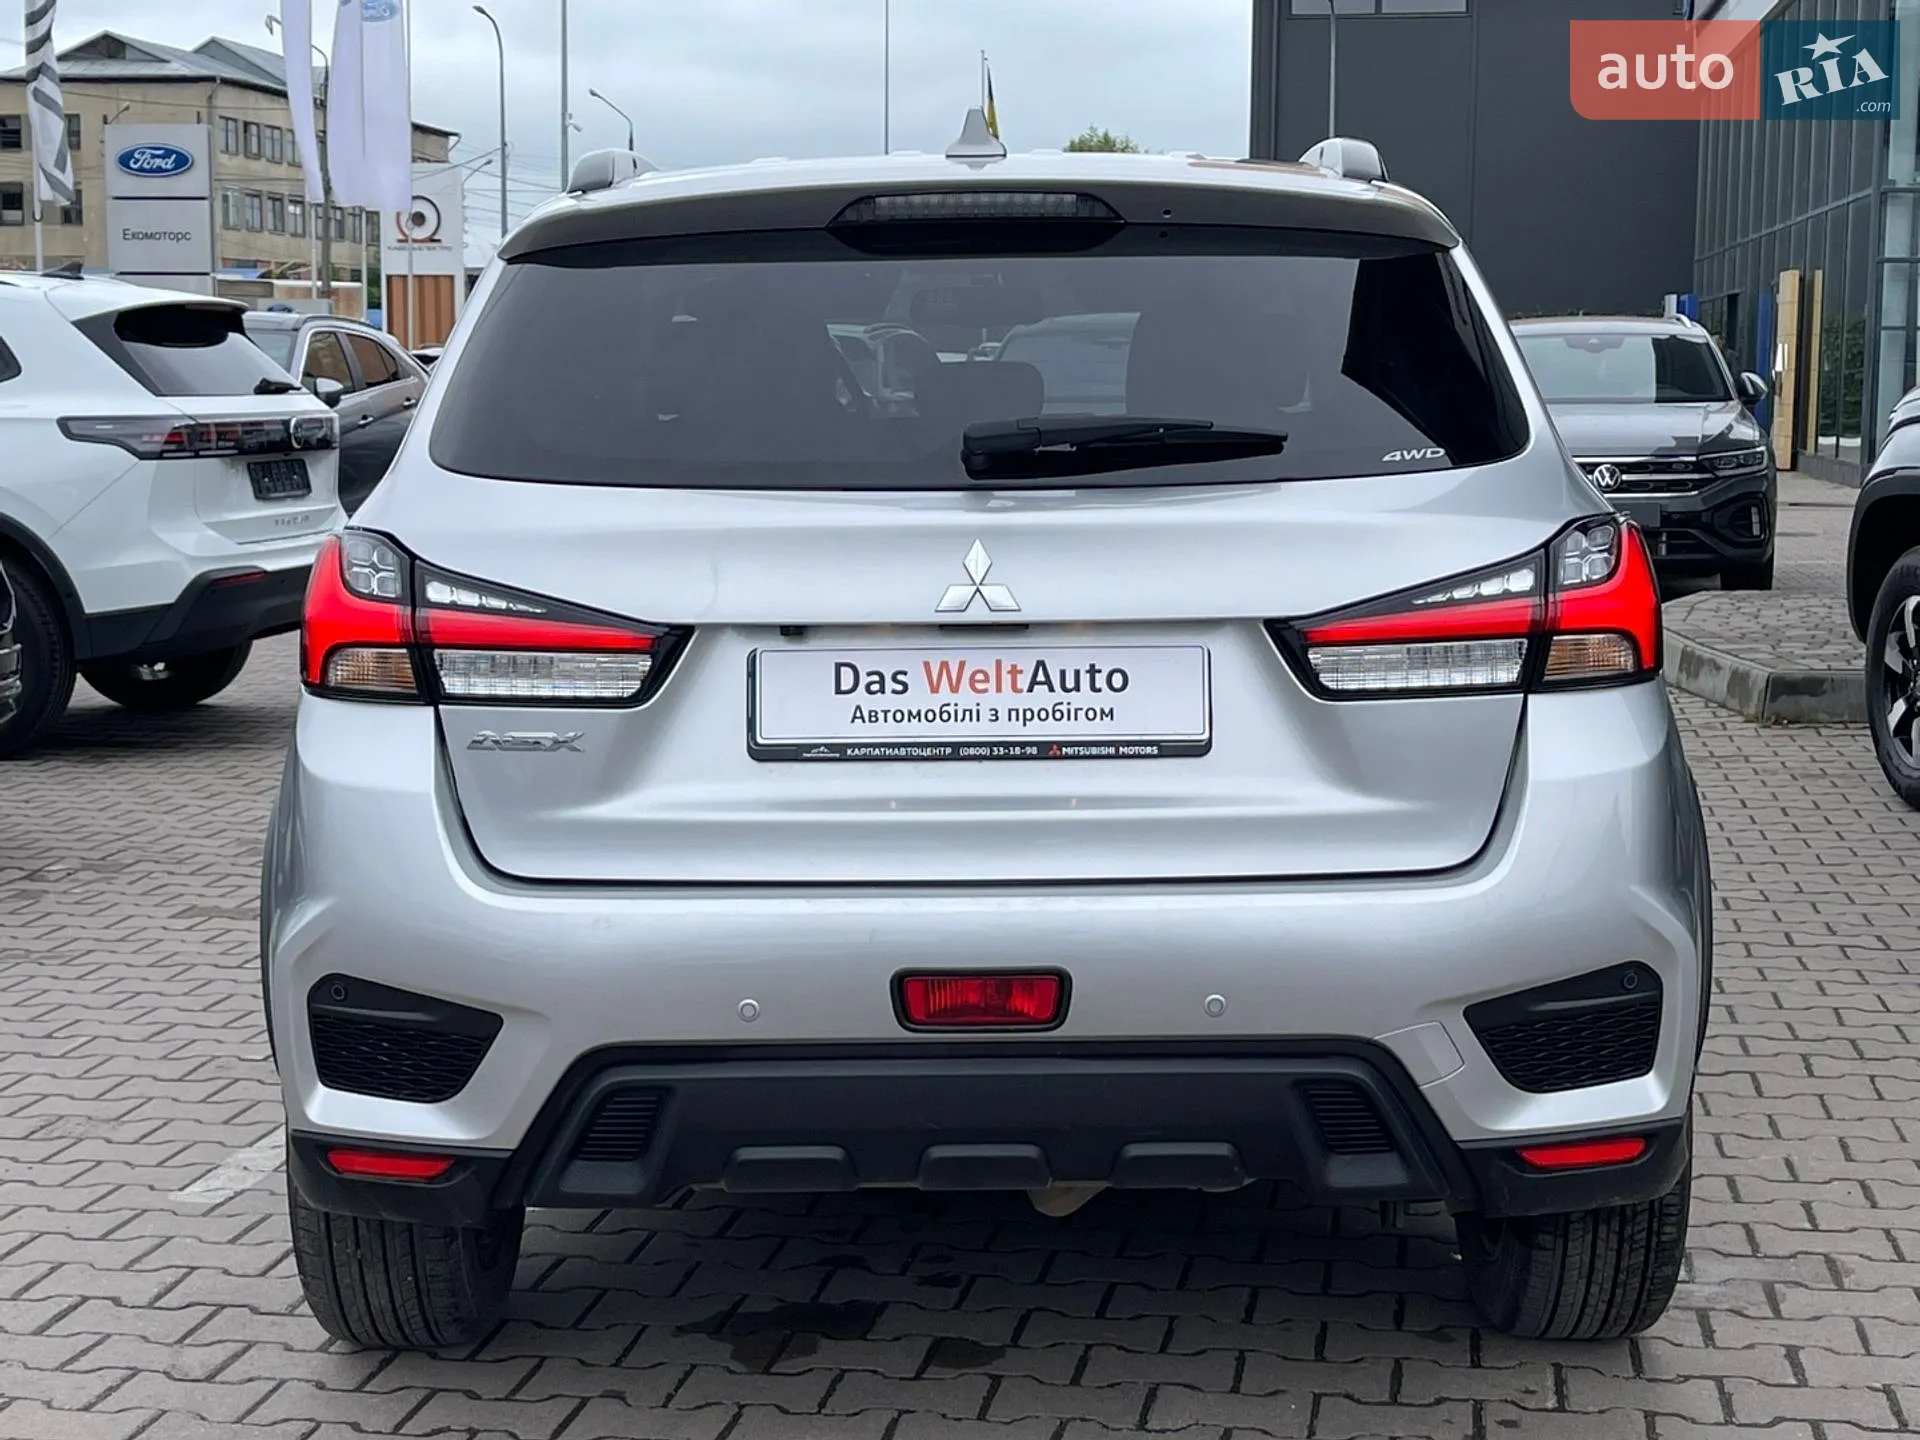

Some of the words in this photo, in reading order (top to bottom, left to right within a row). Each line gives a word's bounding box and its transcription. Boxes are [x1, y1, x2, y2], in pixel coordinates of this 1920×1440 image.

[129, 147, 177, 170] Ford
[122, 228, 192, 244] Екомоторс
[1382, 447, 1446, 462] 4WD
[833, 661, 910, 696] Das
[922, 658, 1130, 695] WeltAuto
[850, 702, 981, 724] Автомобілі
[988, 707, 999, 723] з
[1007, 702, 1115, 727] пробігом
[959, 746, 991, 757] (0800)
[1061, 746, 1116, 756] MITSUBISHI
[1118, 746, 1159, 756] MOTORS
